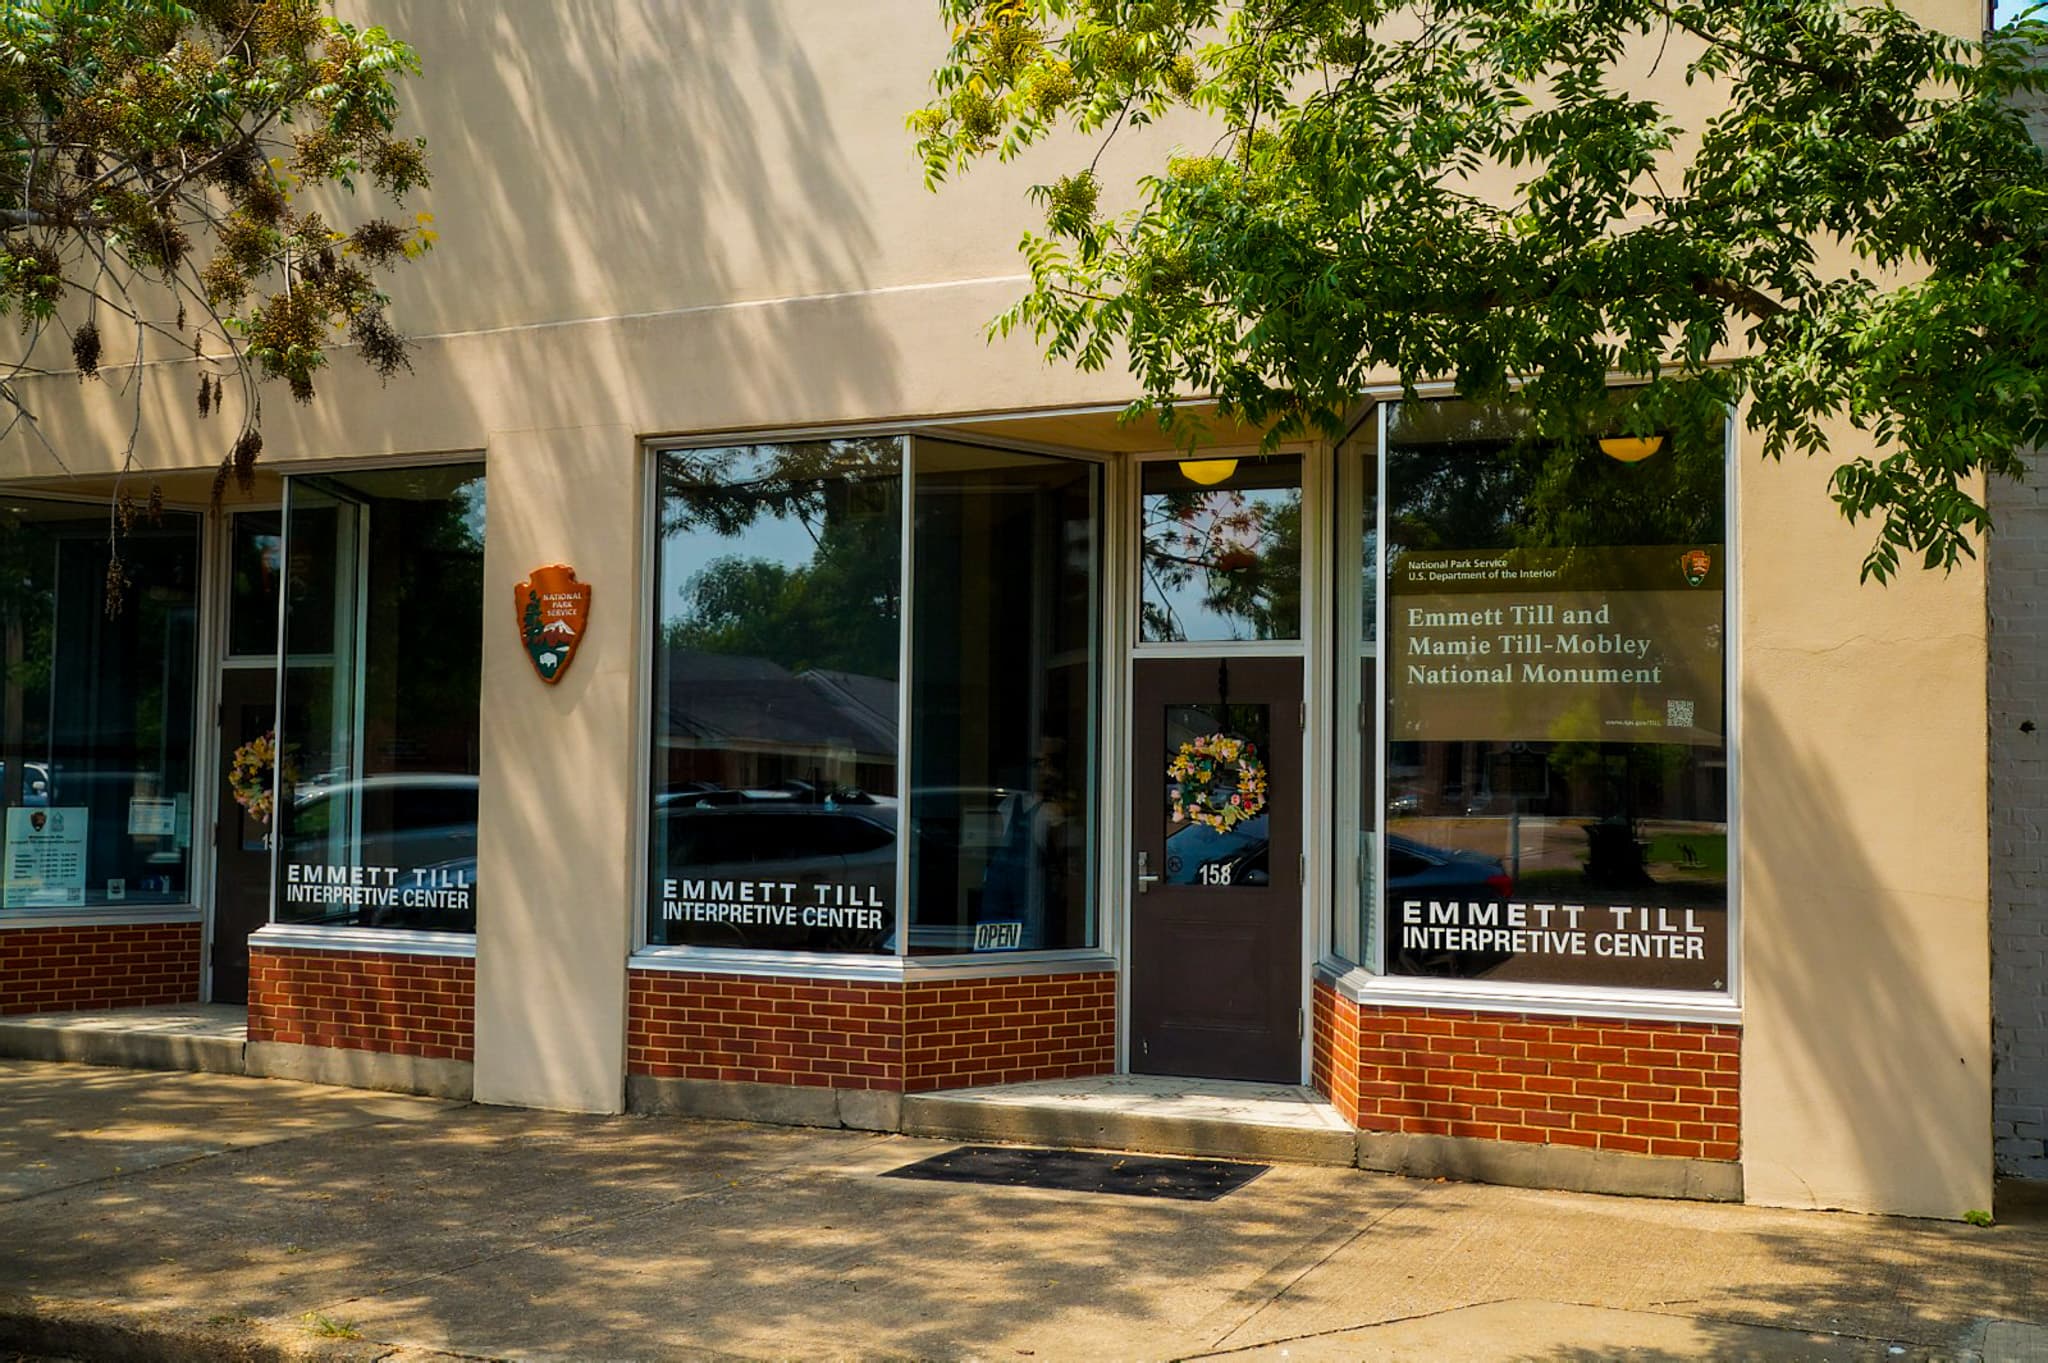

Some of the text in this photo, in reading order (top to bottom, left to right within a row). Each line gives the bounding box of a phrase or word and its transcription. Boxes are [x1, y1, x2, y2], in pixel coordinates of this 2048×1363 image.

[1408, 558, 1508, 570] National Park Service
[1408, 568, 1557, 582] U.S. Department of the Interior
[543, 592, 582, 600] NATIONAL
[552, 601, 573, 609] PARK
[547, 608, 577, 617] SERVICE
[1408, 604, 1610, 627] Emmett Till and
[1408, 633, 1652, 659] Mamie Till-Mobley
[1407, 663, 1662, 684] National Monument
[288, 864, 470, 889] EMMETT TILL
[1200, 864, 1231, 885] 158
[287, 884, 469, 909] INTERPRETIVE CENTER
[663, 878, 883, 907] EMMETT TILL
[662, 901, 883, 930] INTERPRETIVE CENTER
[1402, 901, 1705, 933] EMMETT TILL
[978, 924, 1018, 948] OPEN
[1402, 926, 1705, 960] INTERPRETIVE CENTER
